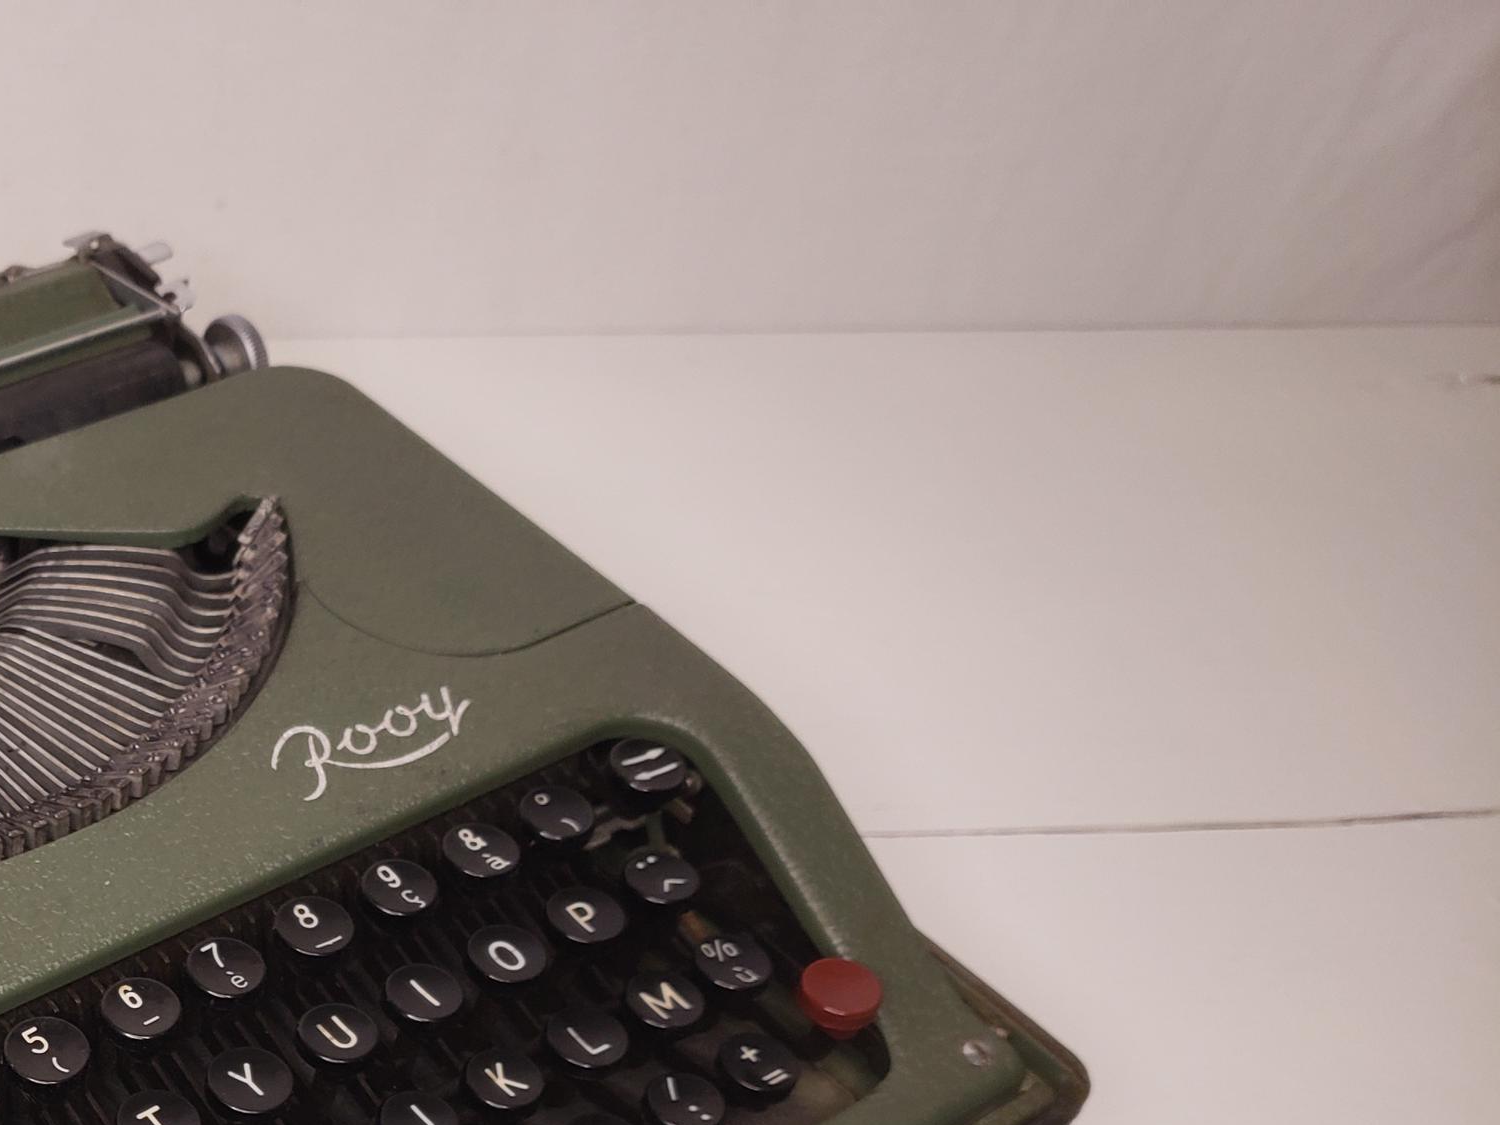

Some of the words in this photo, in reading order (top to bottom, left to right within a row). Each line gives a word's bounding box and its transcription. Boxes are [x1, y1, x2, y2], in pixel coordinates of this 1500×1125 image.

[271, 686, 471, 801] Rooy
[481, 853, 511, 870] à
[376, 865, 402, 889] 9
[400, 889, 427, 909] ç
[293, 903, 319, 929] 8
[565, 901, 595, 933] P
[200, 942, 225, 968] 7
[487, 940, 526, 971] O
[700, 939, 739, 962] %
[118, 984, 143, 1009] 6
[409, 979, 441, 1007] I
[638, 982, 692, 1020] M
[21, 1026, 49, 1054] 5
[316, 1015, 358, 1049] U
[567, 1027, 611, 1055] L
[740, 1046, 758, 1062] +
[227, 1062, 265, 1096] Y
[484, 1062, 530, 1097] K
